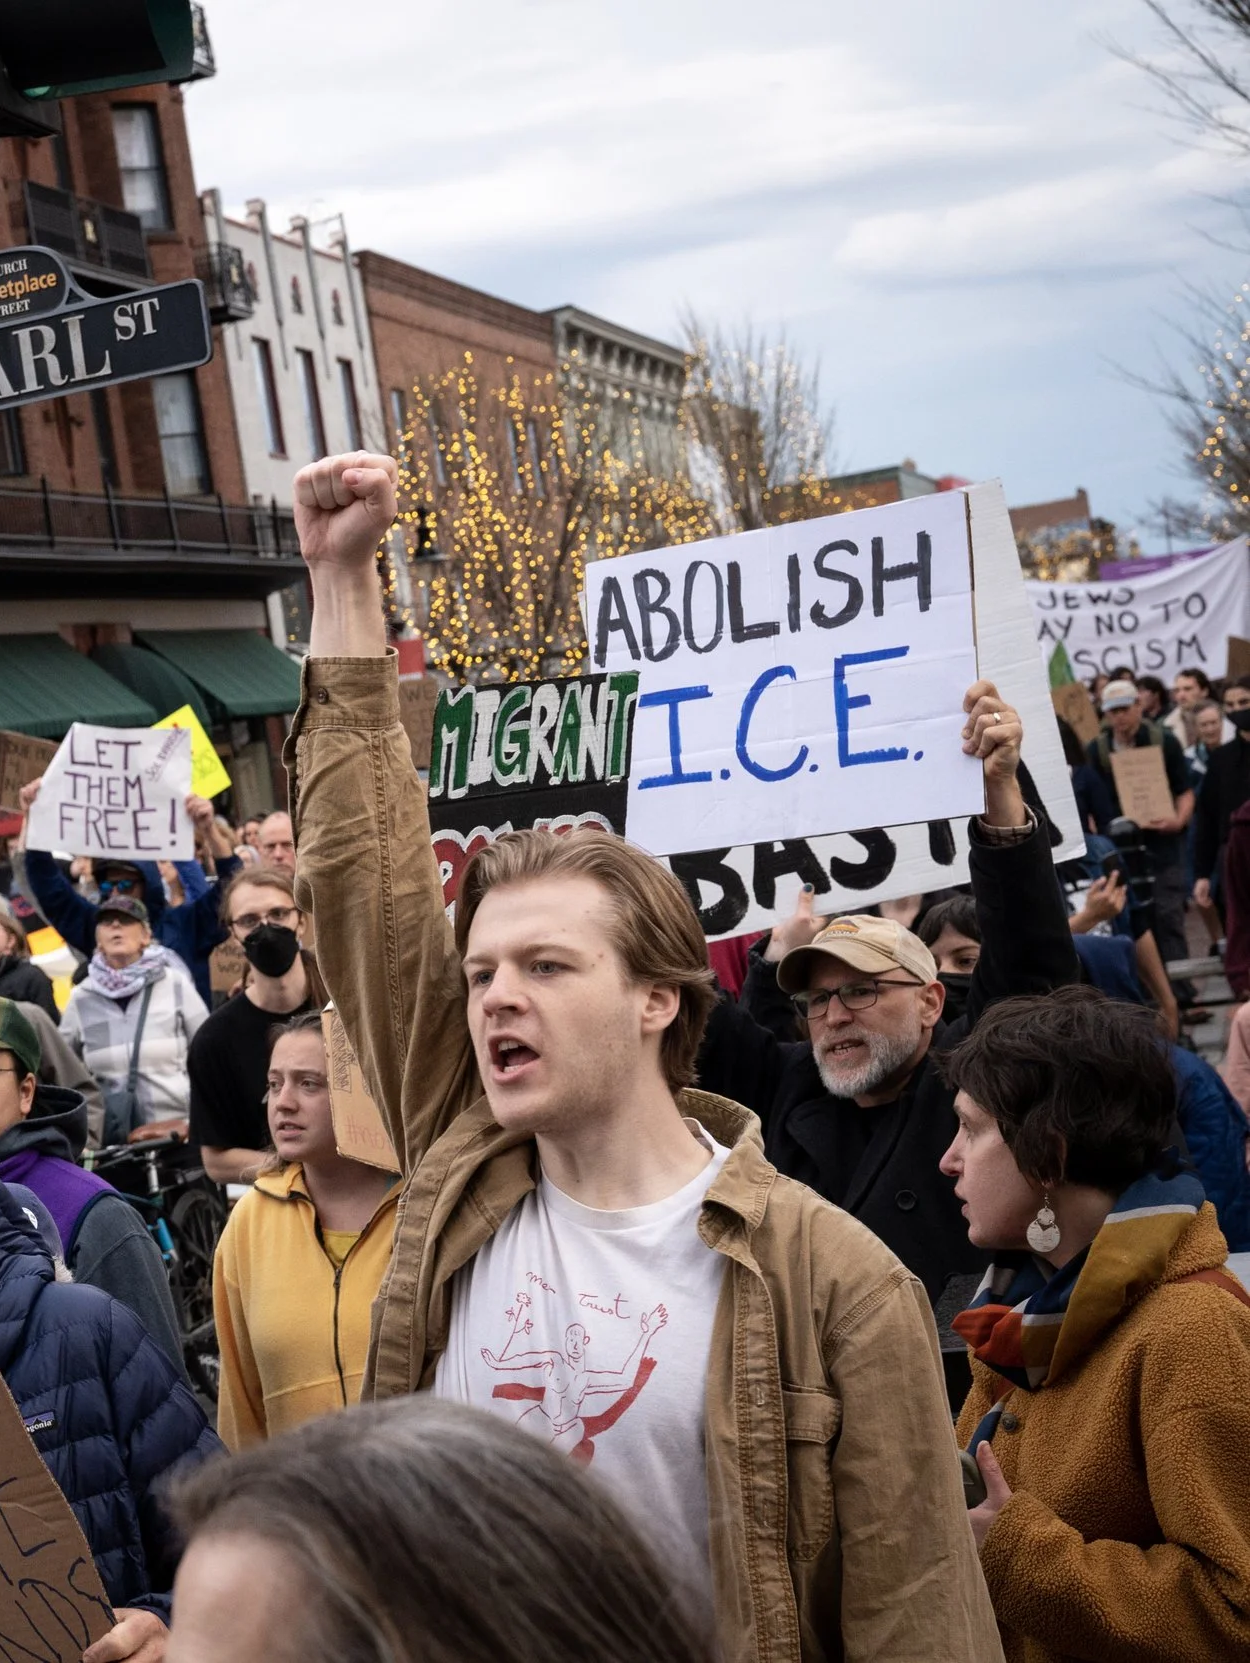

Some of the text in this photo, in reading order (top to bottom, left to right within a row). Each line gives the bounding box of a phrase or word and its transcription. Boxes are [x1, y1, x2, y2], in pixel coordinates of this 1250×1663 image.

[113, 298, 161, 342] ST
[594, 530, 933, 668] ABOLISH
[1038, 591, 1208, 642] AY NO TO
[1073, 633, 1207, 679] SCISM
[429, 671, 641, 799] MIGRANT
[637, 645, 925, 790] I.C.E.
[69, 725, 142, 770] LET
[63, 771, 145, 808] THEM
[60, 799, 177, 851] FREE!
[578, 1292, 631, 1320] Trust
